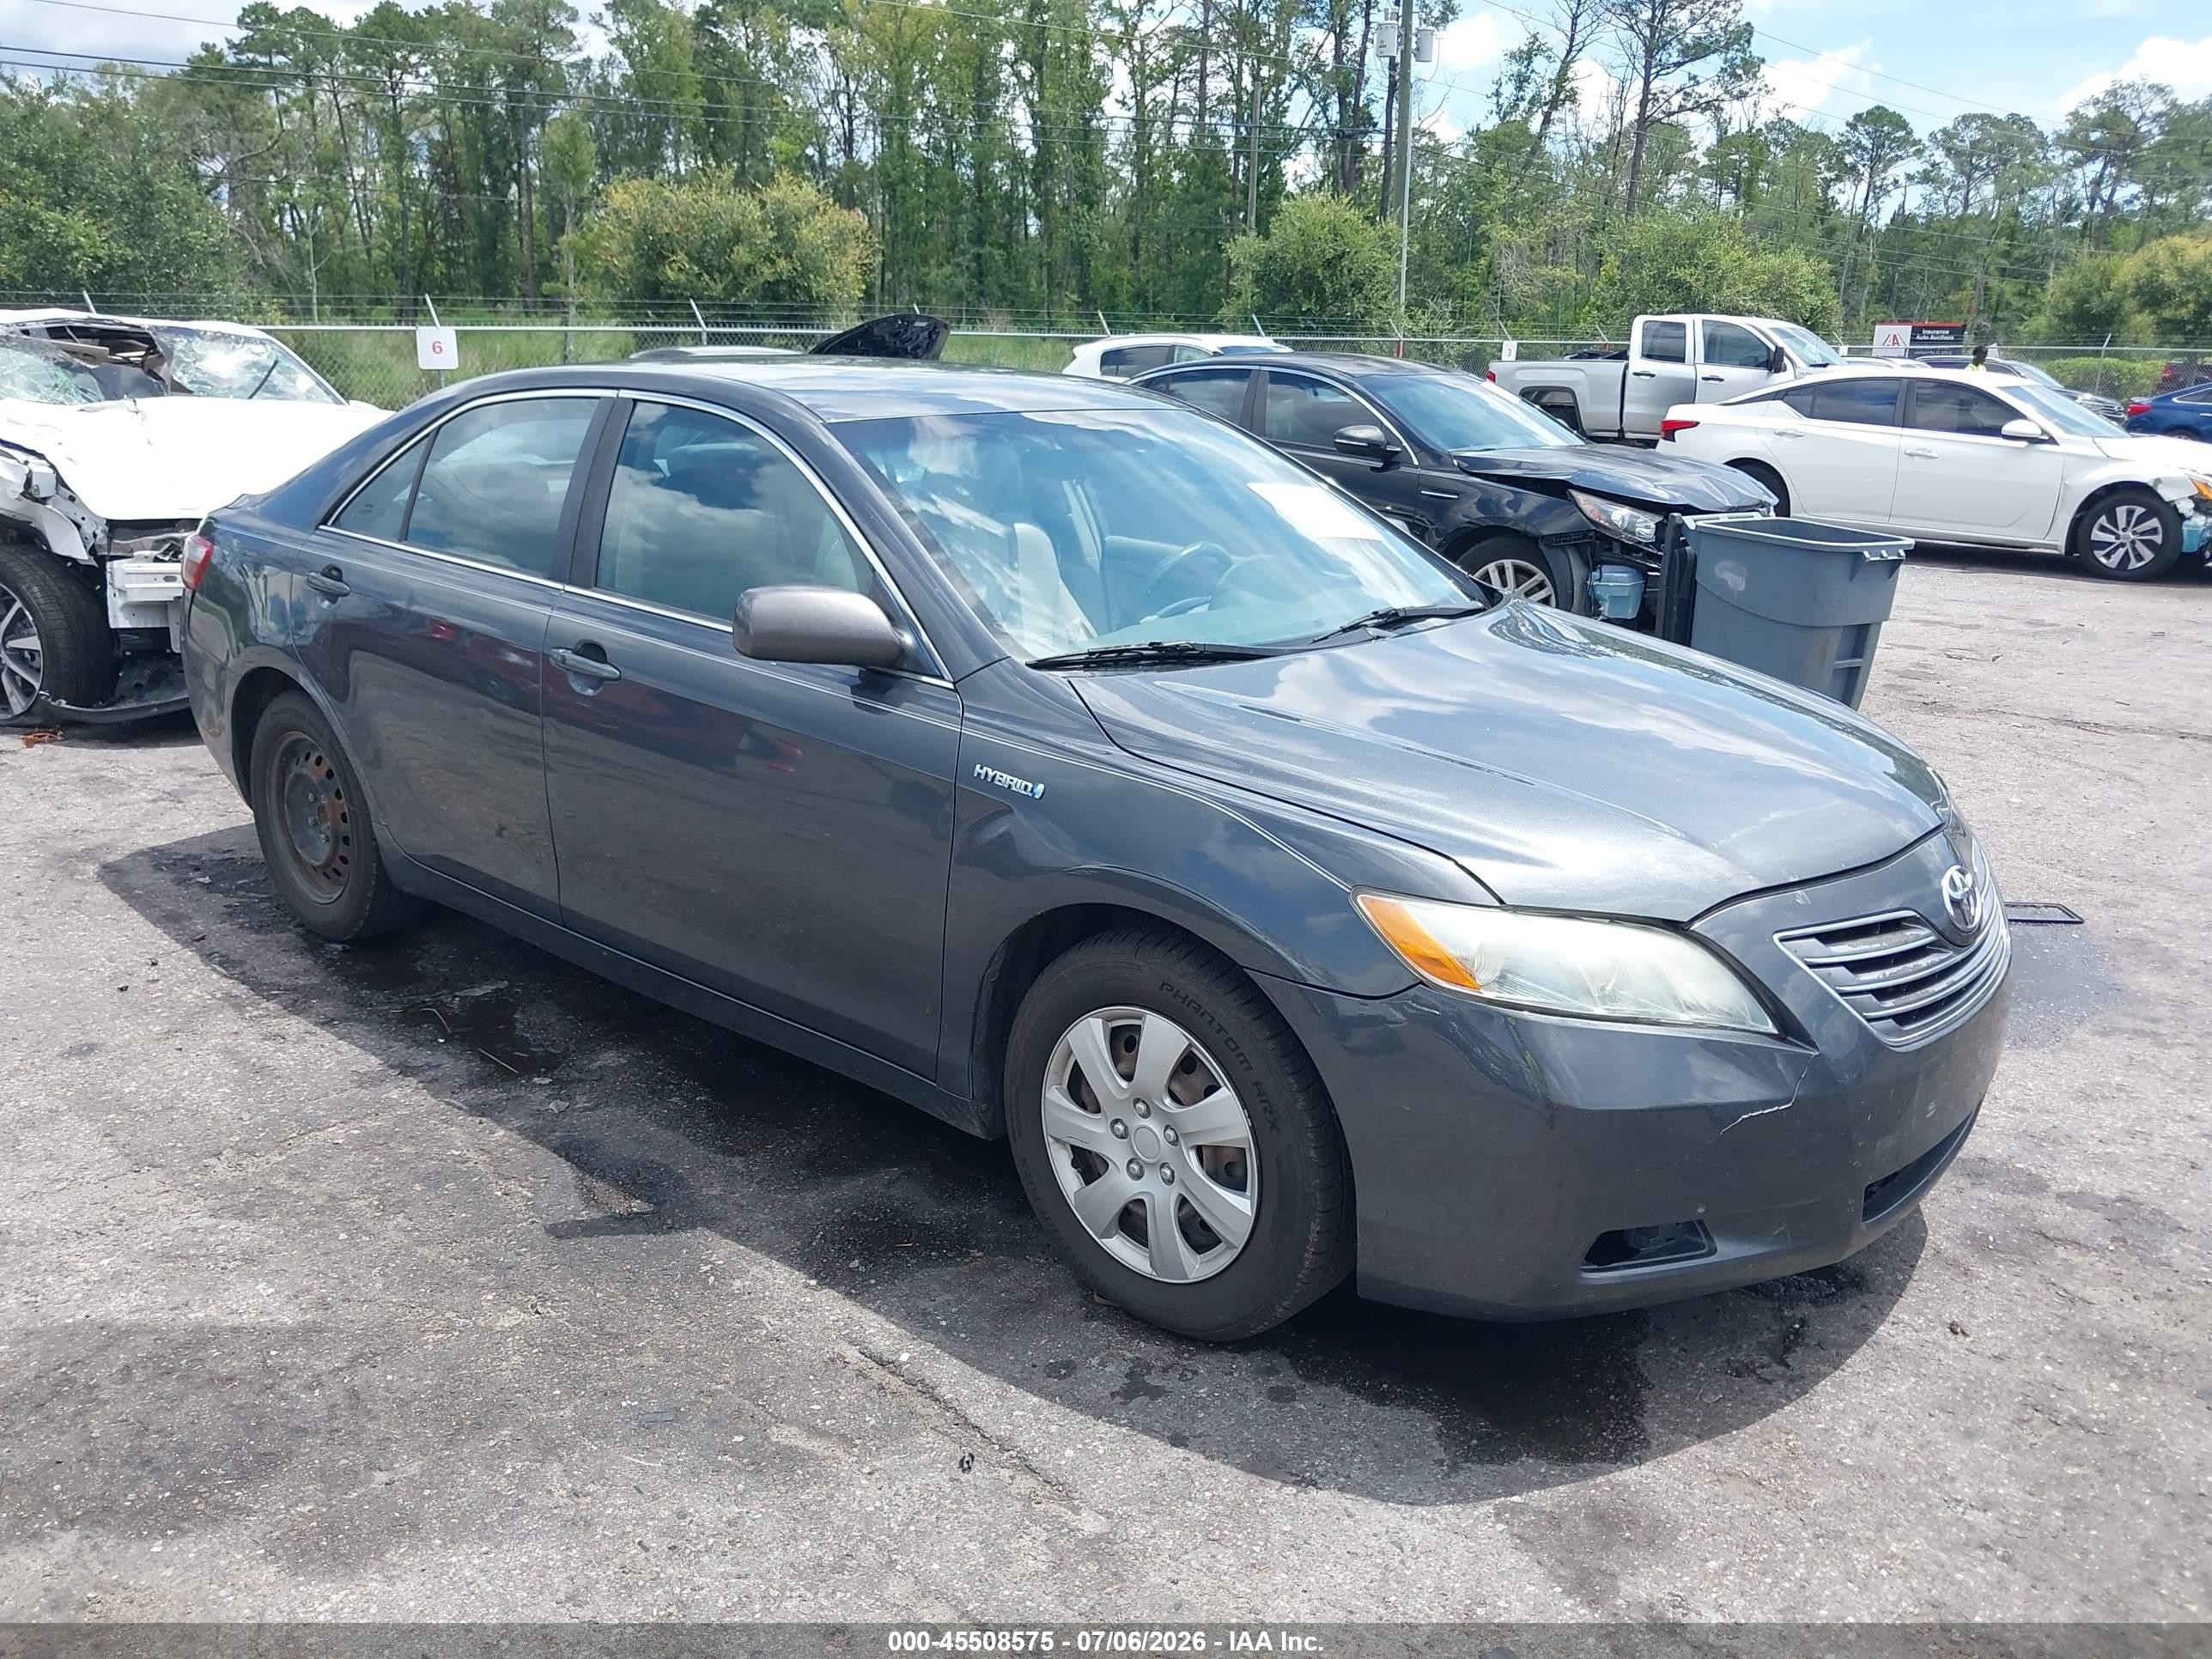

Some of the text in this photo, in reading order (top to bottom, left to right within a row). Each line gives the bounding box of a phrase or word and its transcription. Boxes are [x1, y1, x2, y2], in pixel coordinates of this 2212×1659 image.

[432, 341, 443, 355] 6
[1507, 348, 1512, 357] 3
[973, 763, 1034, 797] HYBRID
[1159, 981, 1254, 1072] PHANTOM
